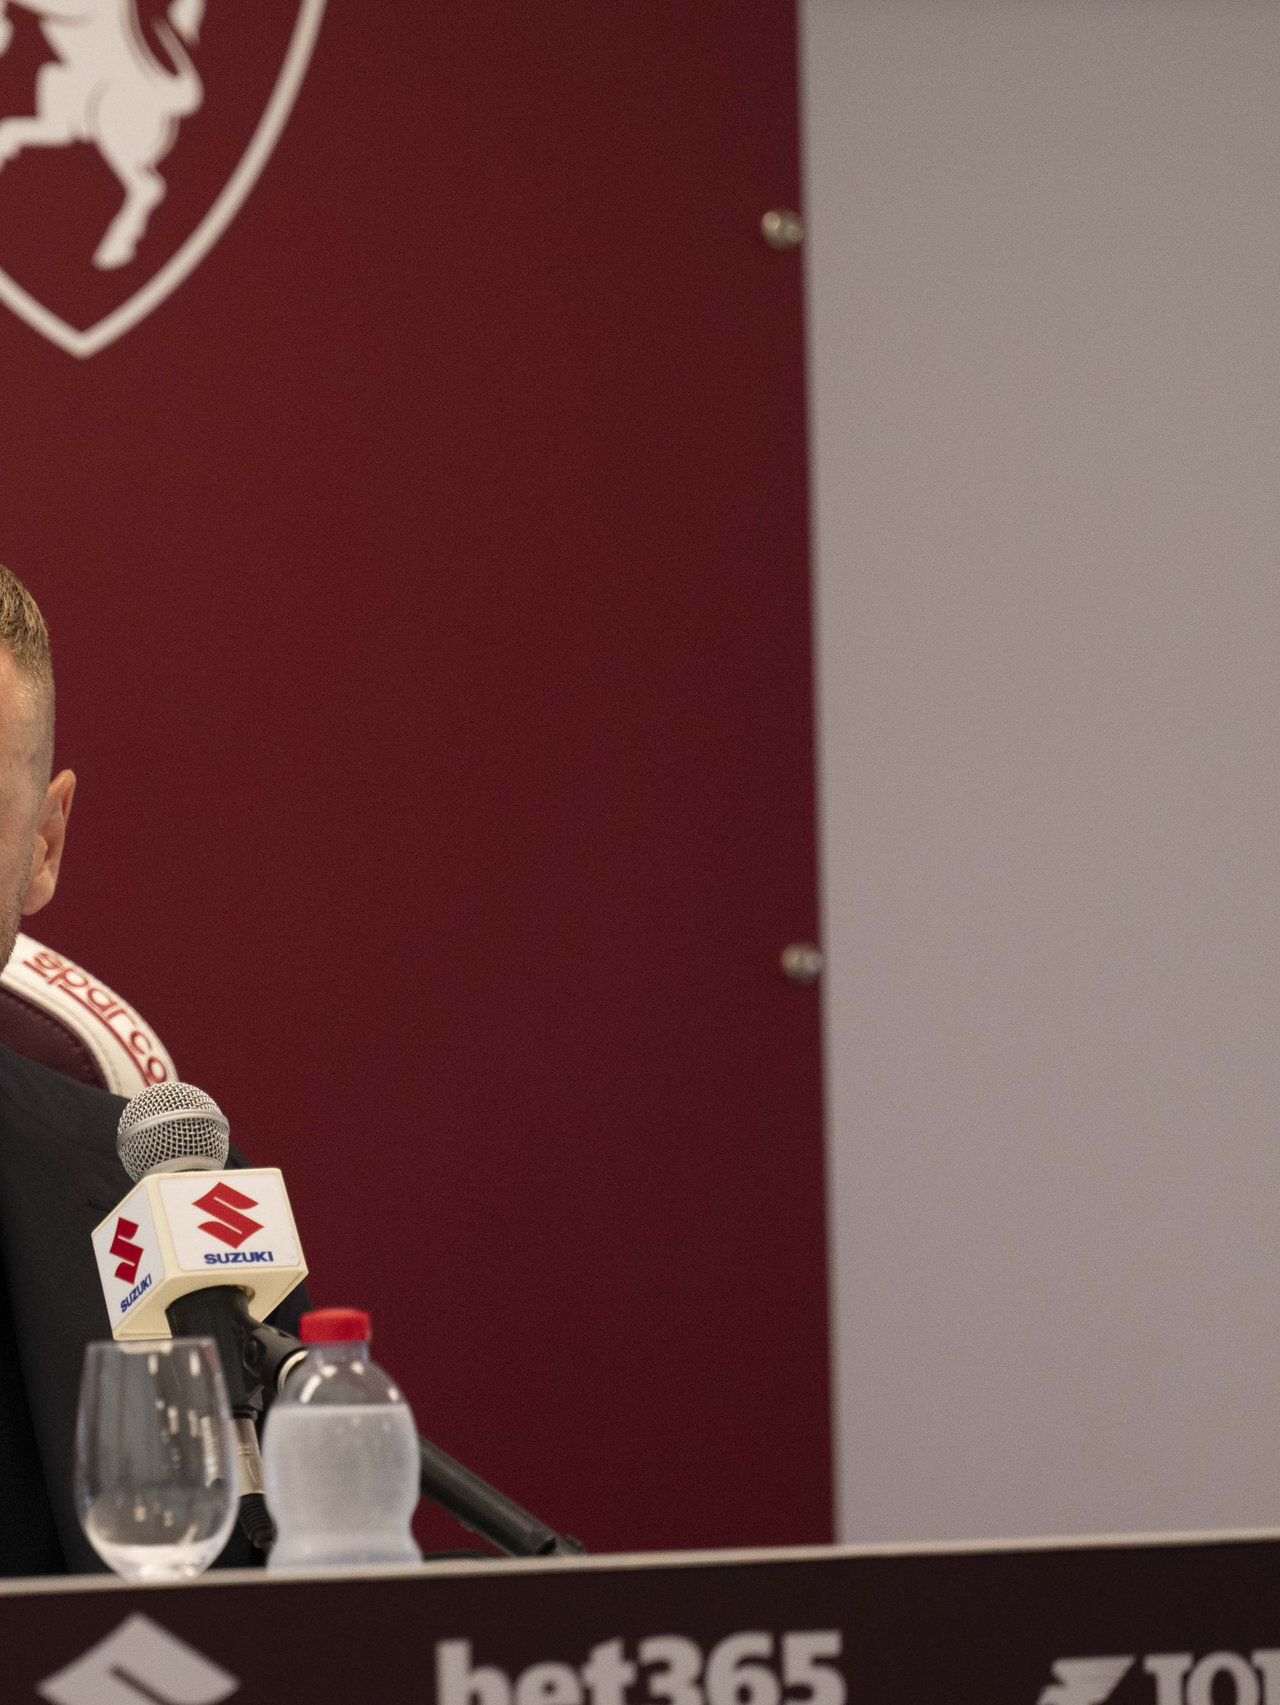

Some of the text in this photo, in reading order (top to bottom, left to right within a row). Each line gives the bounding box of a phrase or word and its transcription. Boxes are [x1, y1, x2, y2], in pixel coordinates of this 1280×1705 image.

[24, 951, 168, 1084] sparco
[203, 1251, 274, 1265] SUZUKI
[120, 1273, 153, 1313] SUZUKI
[434, 1629, 847, 1705] bet365
